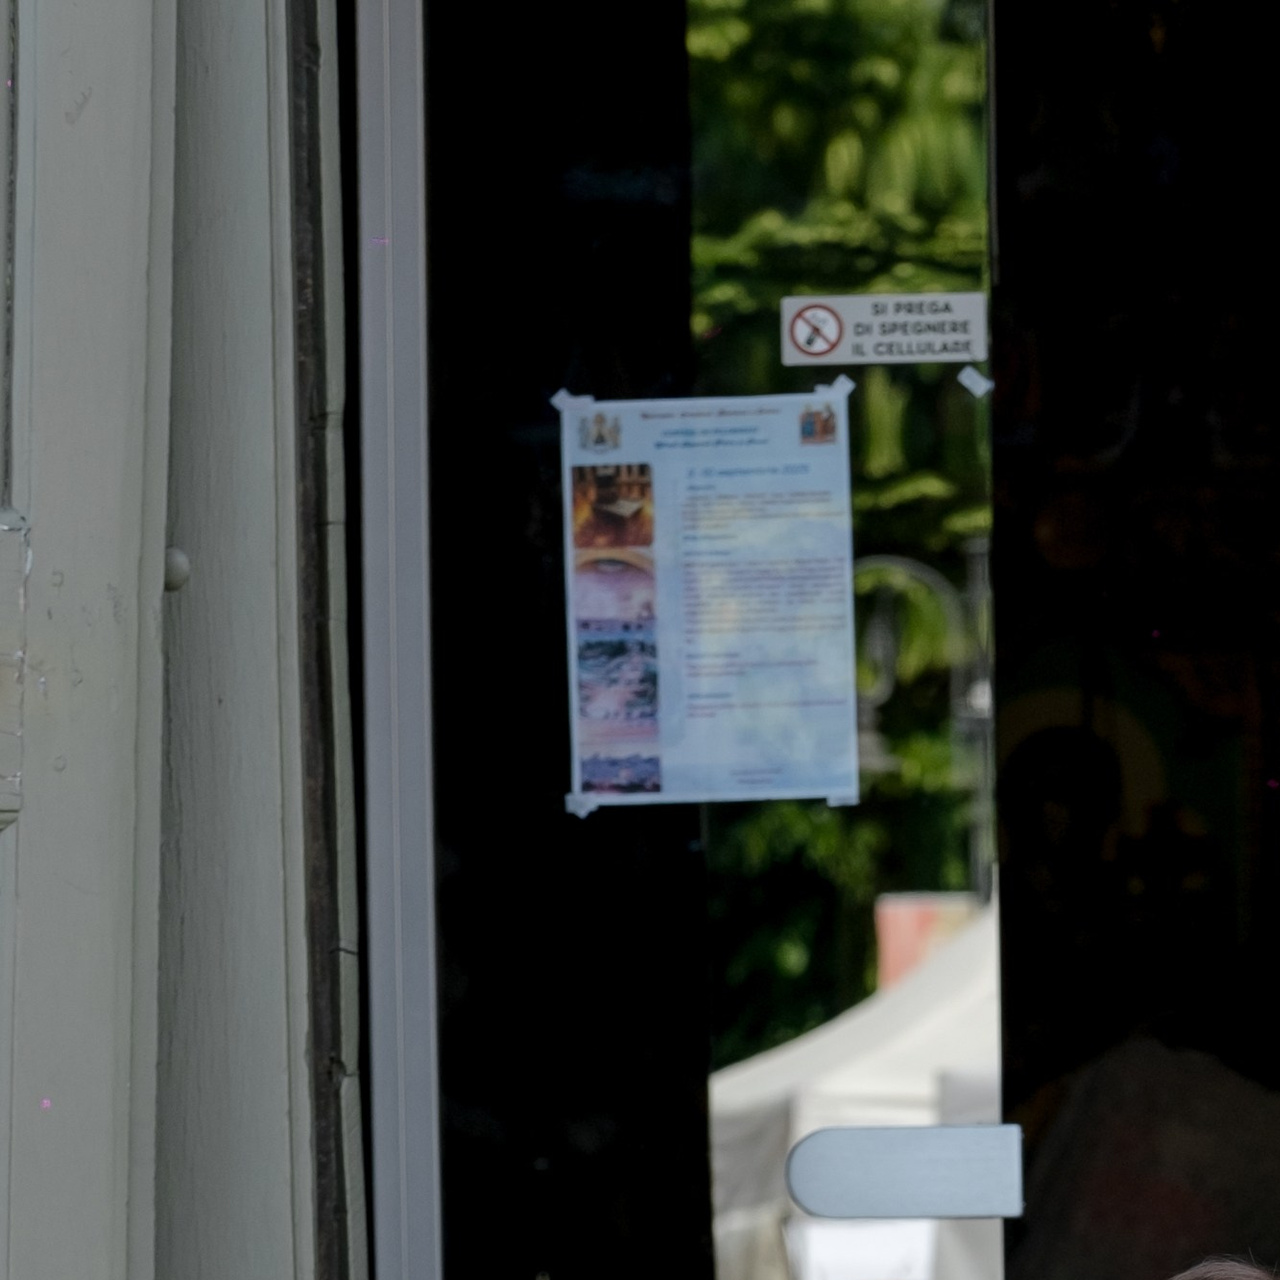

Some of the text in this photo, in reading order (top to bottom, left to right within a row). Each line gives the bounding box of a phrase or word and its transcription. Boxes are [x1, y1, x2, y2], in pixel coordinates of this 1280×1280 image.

[871, 301, 952, 315] SI PREGA
[853, 320, 970, 336] DI SPEGNERE
[851, 341, 971, 357] IL CELLULARE
